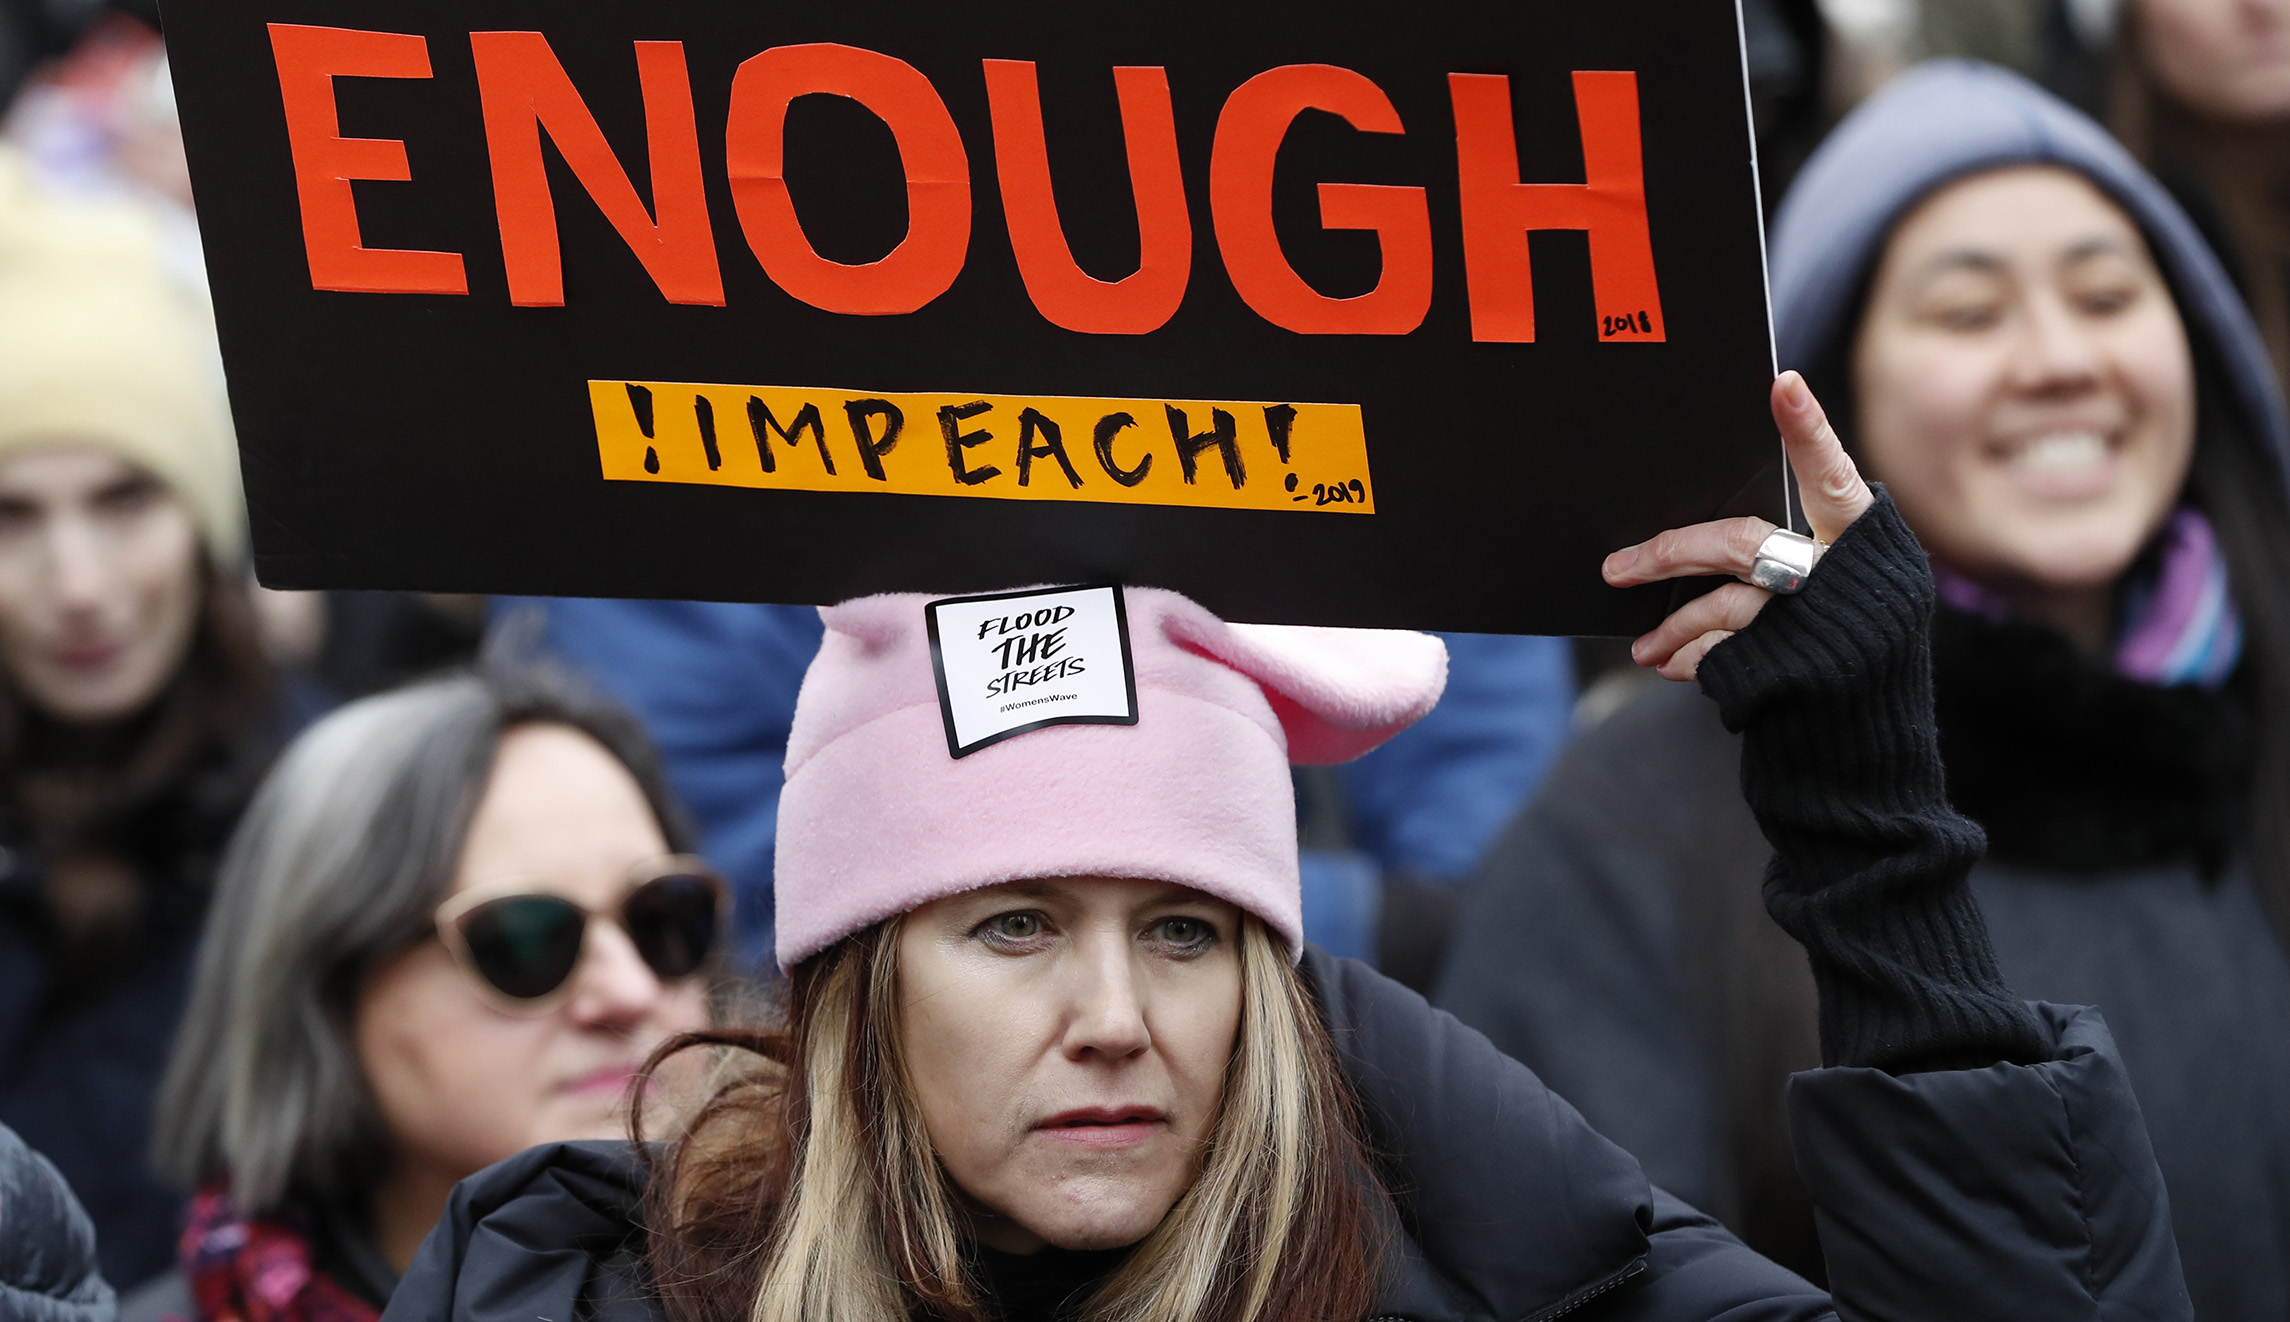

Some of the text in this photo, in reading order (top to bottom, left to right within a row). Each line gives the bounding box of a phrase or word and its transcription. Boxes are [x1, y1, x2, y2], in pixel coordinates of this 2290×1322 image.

[267, 23, 1666, 342] ENOUGH
[1603, 310, 1652, 336] 2018
[977, 606, 1075, 640] FLOOD
[991, 627, 1068, 670] THE
[986, 656, 1085, 699] STREETS
[1000, 693, 1078, 713] #WomensWave
